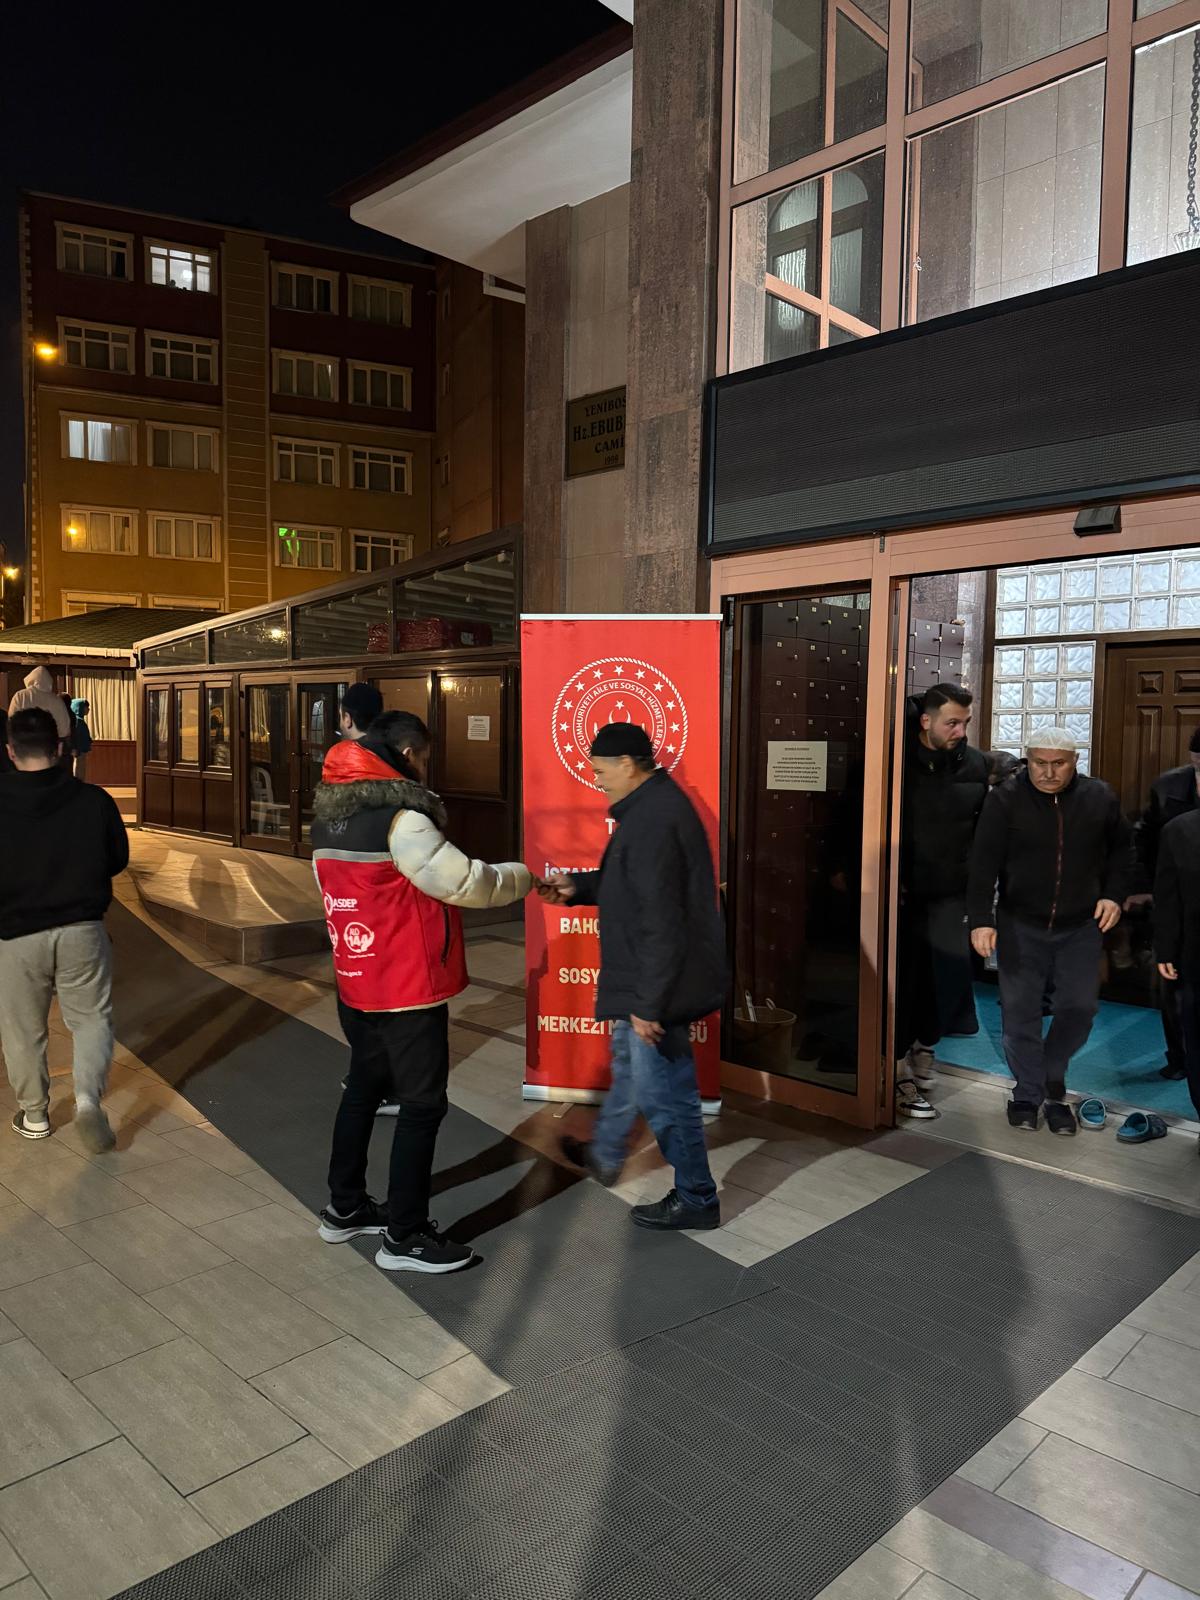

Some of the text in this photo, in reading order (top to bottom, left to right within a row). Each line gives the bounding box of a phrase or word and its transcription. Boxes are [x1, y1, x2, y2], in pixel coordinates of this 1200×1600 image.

[573, 415, 626, 442] Hz.EBUB
[593, 685, 609, 697] AİLE
[620, 682, 648, 698] SOSYAL
[646, 696, 664, 738] HİZMETLER
[333, 898, 358, 908] ASDEP
[559, 967, 600, 985] SOSY
